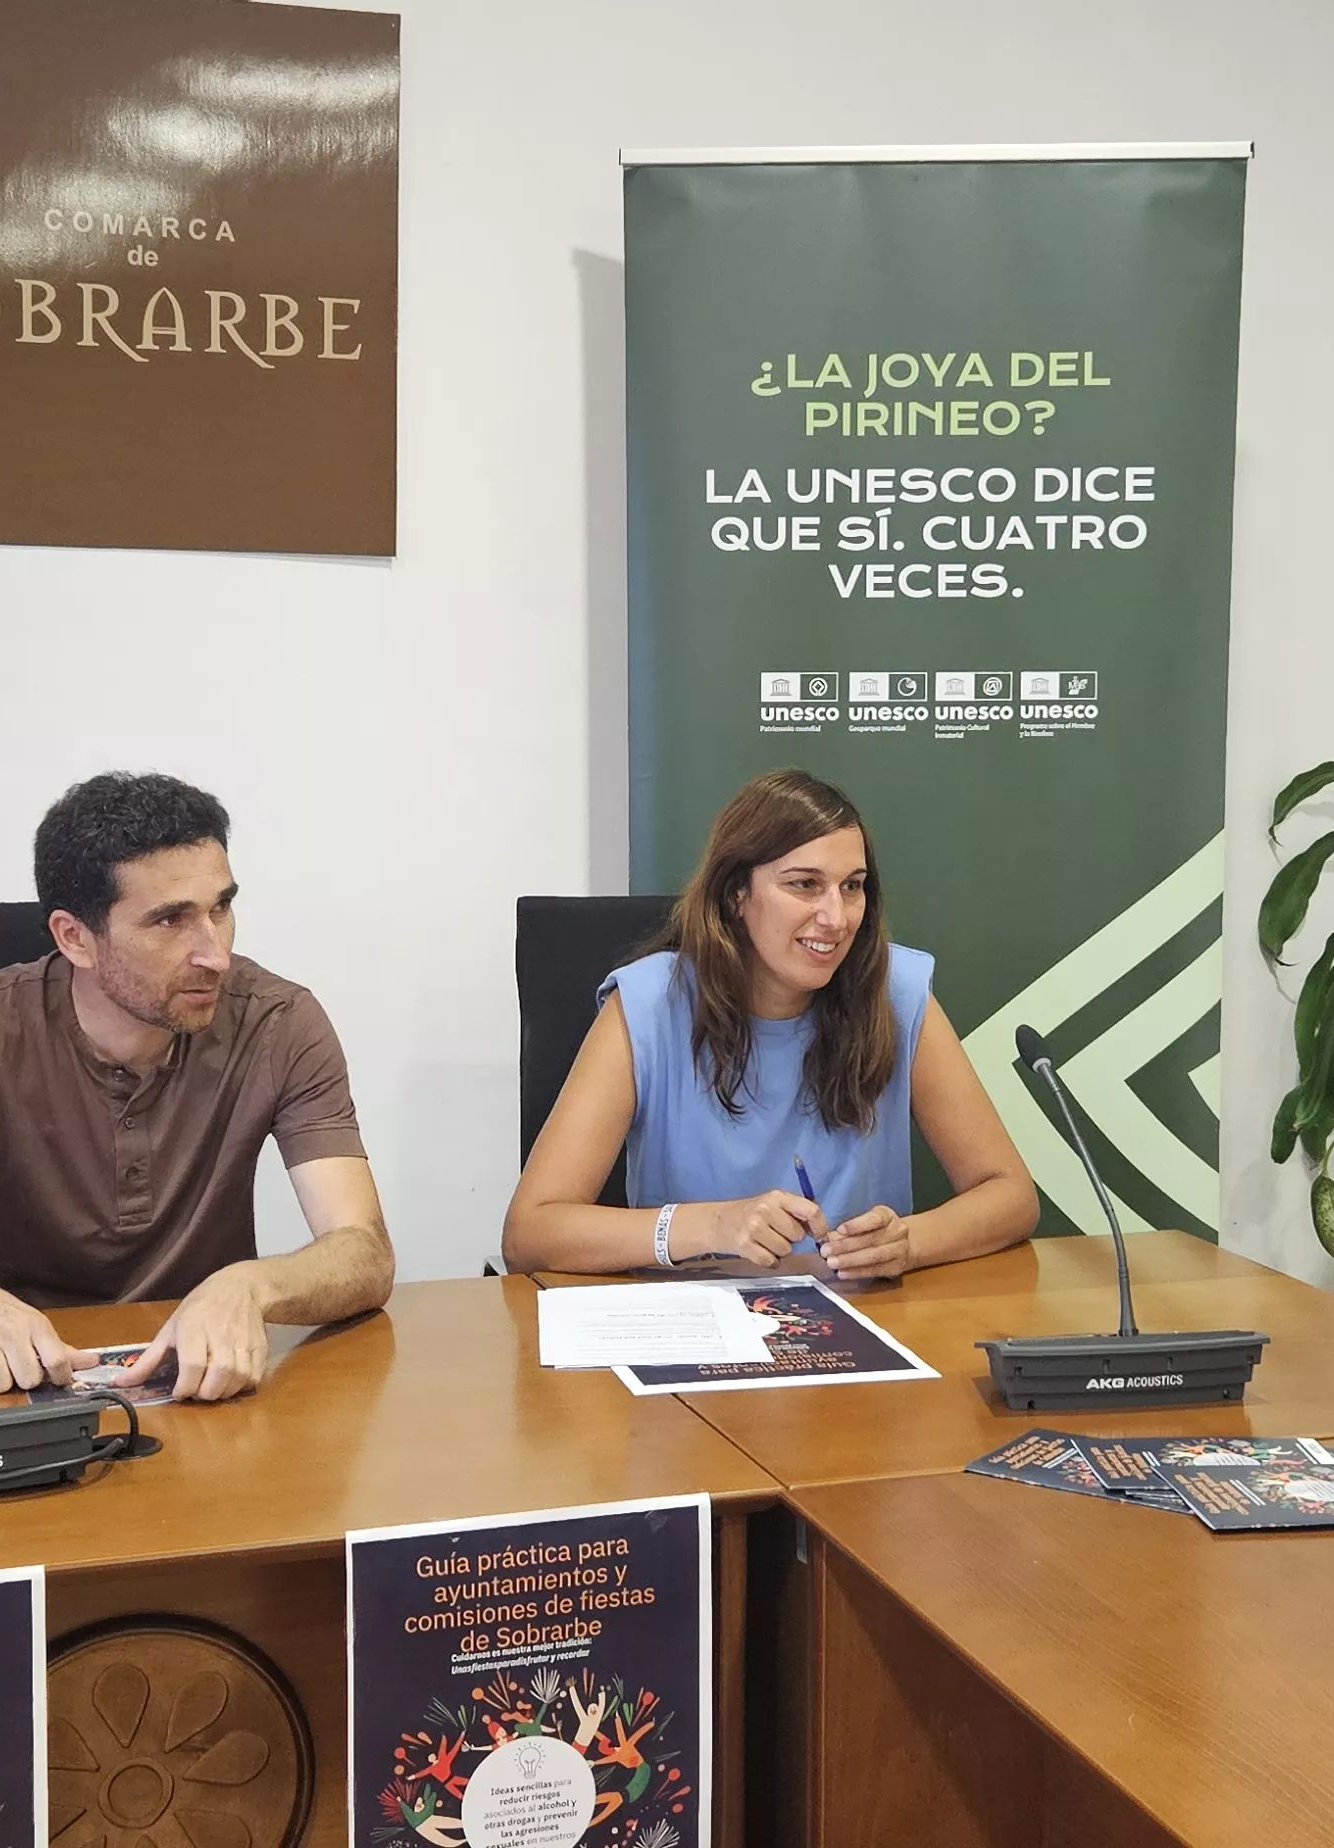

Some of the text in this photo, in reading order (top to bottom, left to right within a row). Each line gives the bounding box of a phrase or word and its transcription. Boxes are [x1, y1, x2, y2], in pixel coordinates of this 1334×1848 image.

[44, 208, 237, 244] COMARCA
[127, 244, 159, 268] de
[750, 351, 1111, 399] ¿LA JOYA DEL
[805, 400, 1056, 437] PIRINEO?
[705, 466, 1156, 504] LA UNESCO DICE
[711, 508, 1148, 552] QUE SÍ. CUATRO
[828, 563, 1024, 599] VECES.
[760, 706, 840, 721] unesco
[848, 706, 929, 721] unesco
[935, 705, 1014, 720] unesco
[1020, 704, 1099, 719] unesco
[1086, 1374, 1184, 1390] AKG ACOUSTICS
[416, 1537, 629, 1578] Guía práctica para
[434, 1564, 627, 1607] ayuntamientos y
[404, 1584, 656, 1633] comisiones de fiestas
[460, 1616, 602, 1653] de Sobrarbe
[492, 1650, 501, 1658] es
[502, 1645, 532, 1656] nuestra
[533, 1642, 554, 1653] mejor
[491, 1779, 572, 1796] Ideas sencillas para
[499, 1791, 561, 1805] reducir riesgos
[484, 1806, 526, 1819] asociados
[538, 1799, 569, 1811] alcohol
[484, 1819, 505, 1830] otras
[507, 1815, 535, 1826] drogas
[543, 1809, 578, 1822] prevenir
[501, 1823, 559, 1838] las agresiones
[539, 1832, 576, 1843] nuestros
